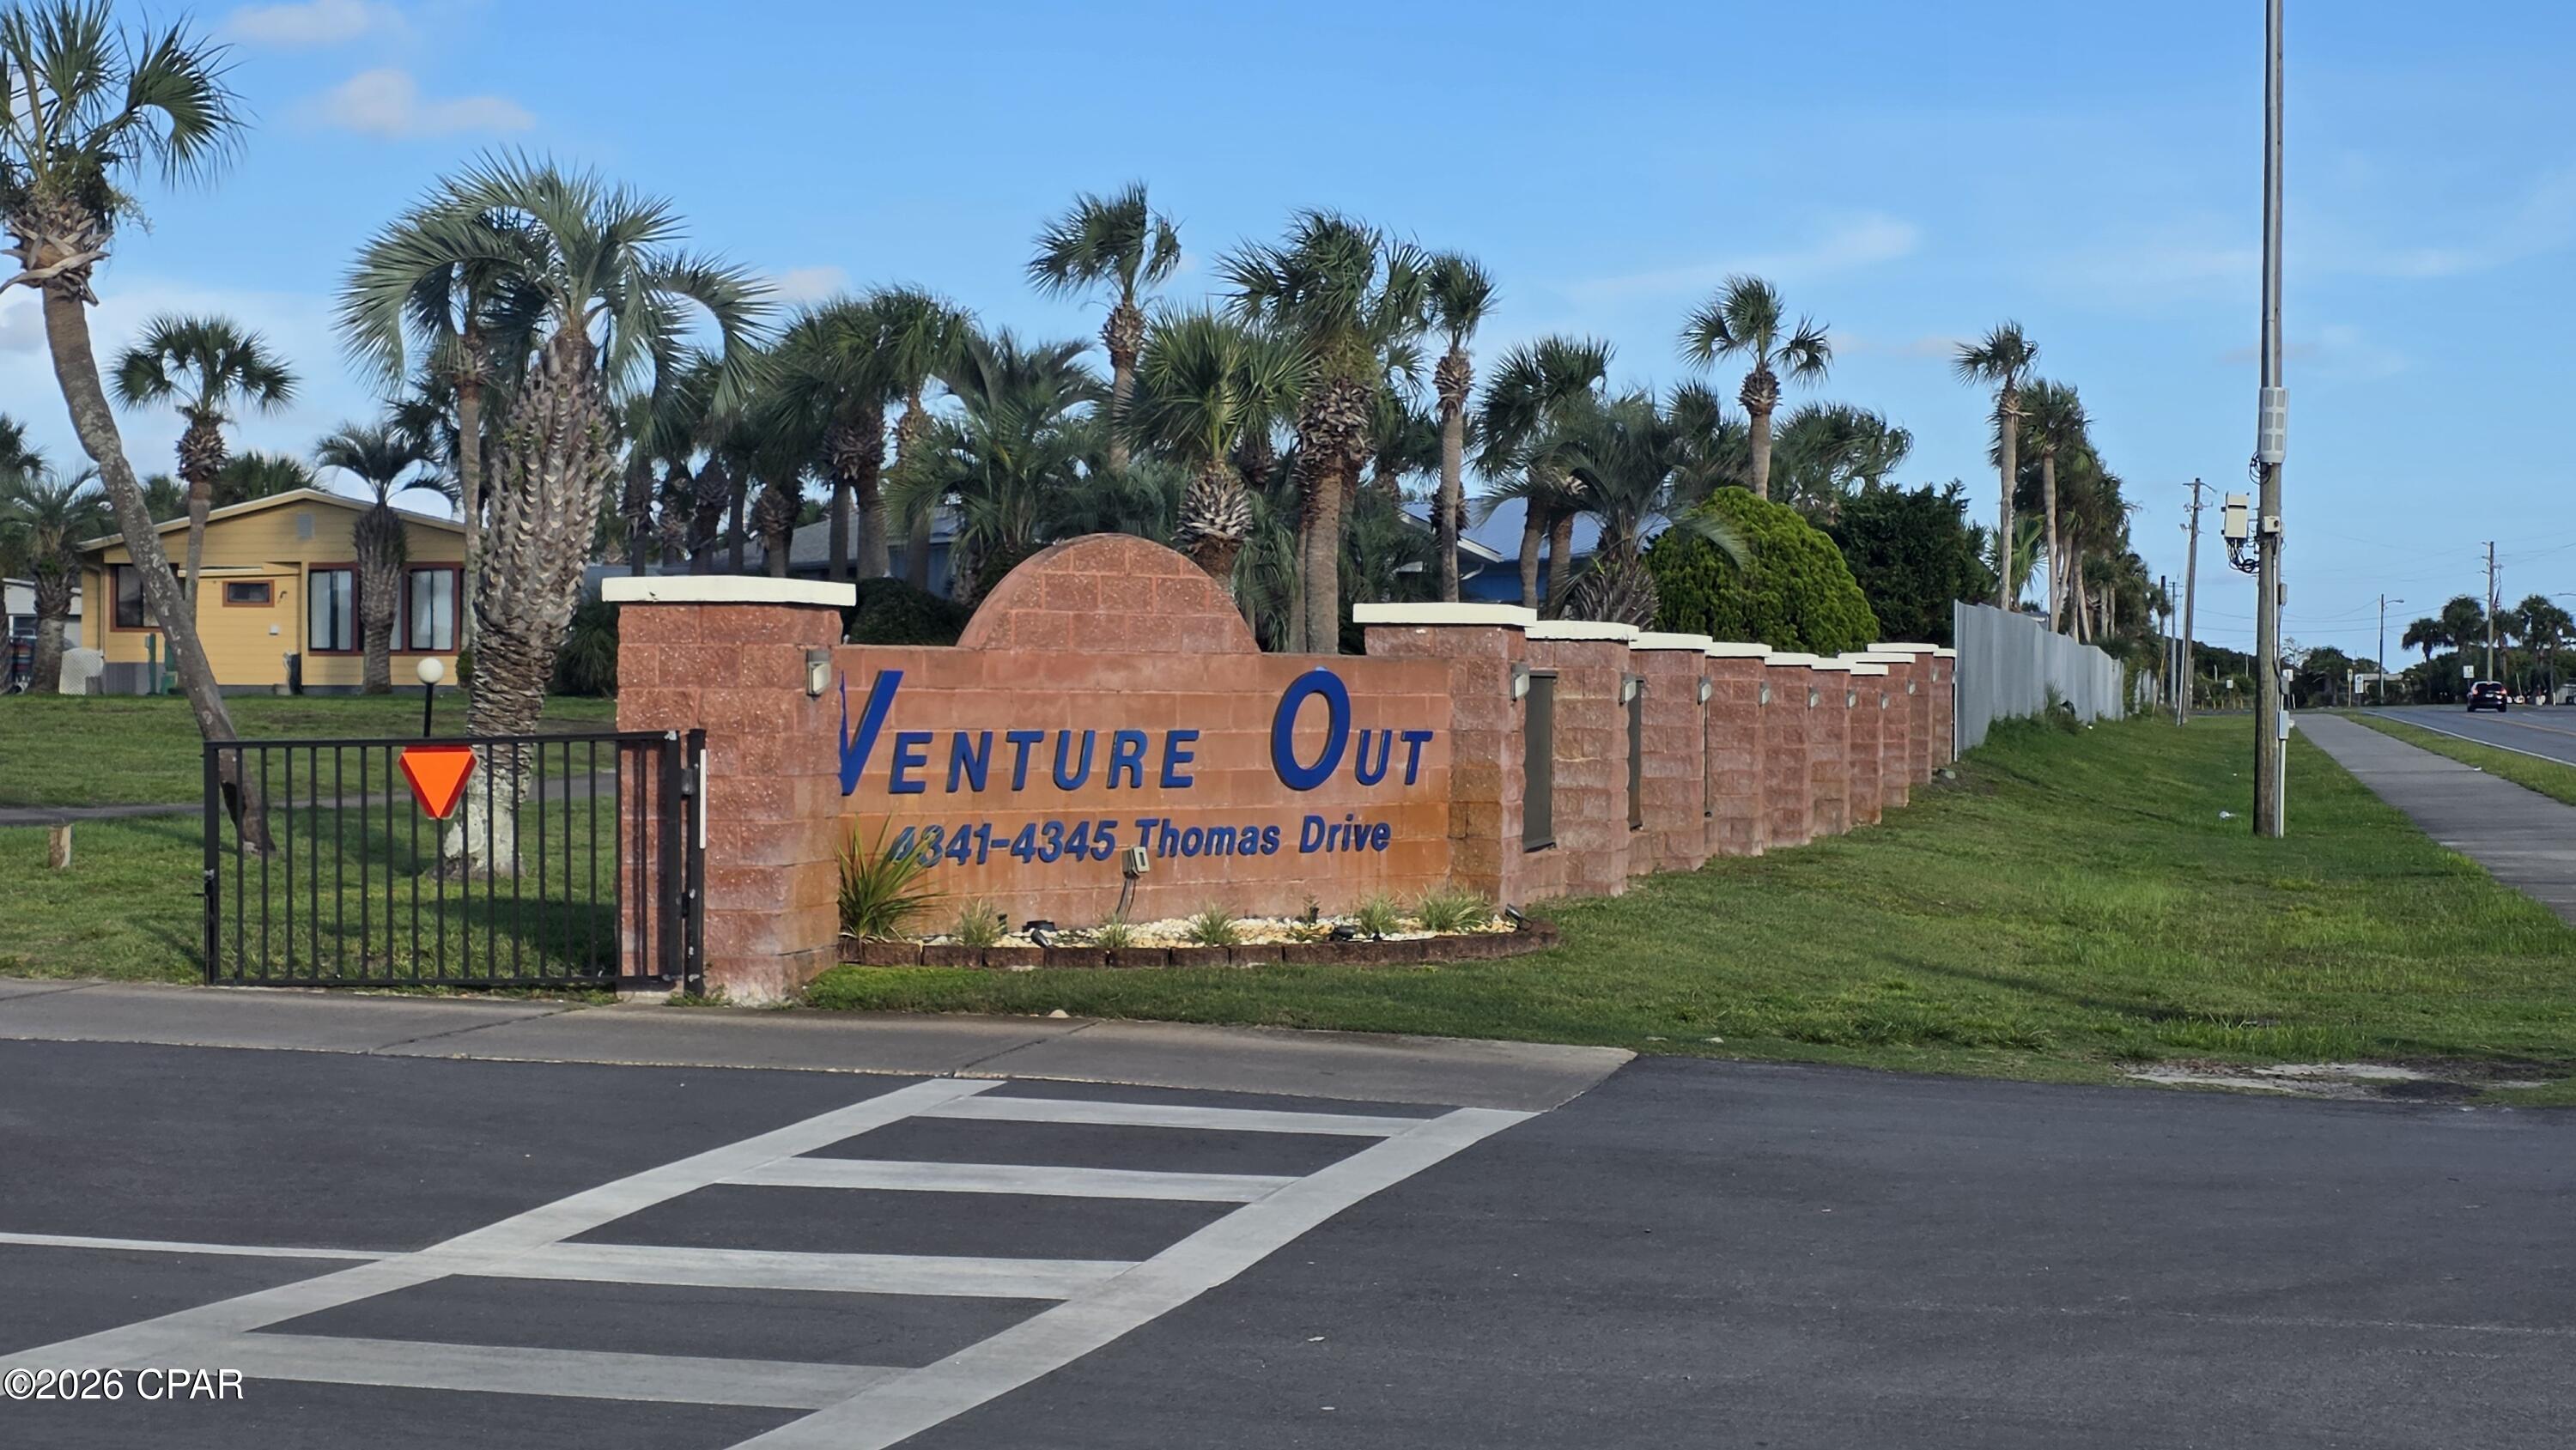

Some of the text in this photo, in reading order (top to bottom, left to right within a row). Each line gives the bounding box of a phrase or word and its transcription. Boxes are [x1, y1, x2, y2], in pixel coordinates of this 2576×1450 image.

[839, 669, 1433, 796] VENTURE OUT
[889, 814, 1391, 868] 4341-4345 Thomas Drive
